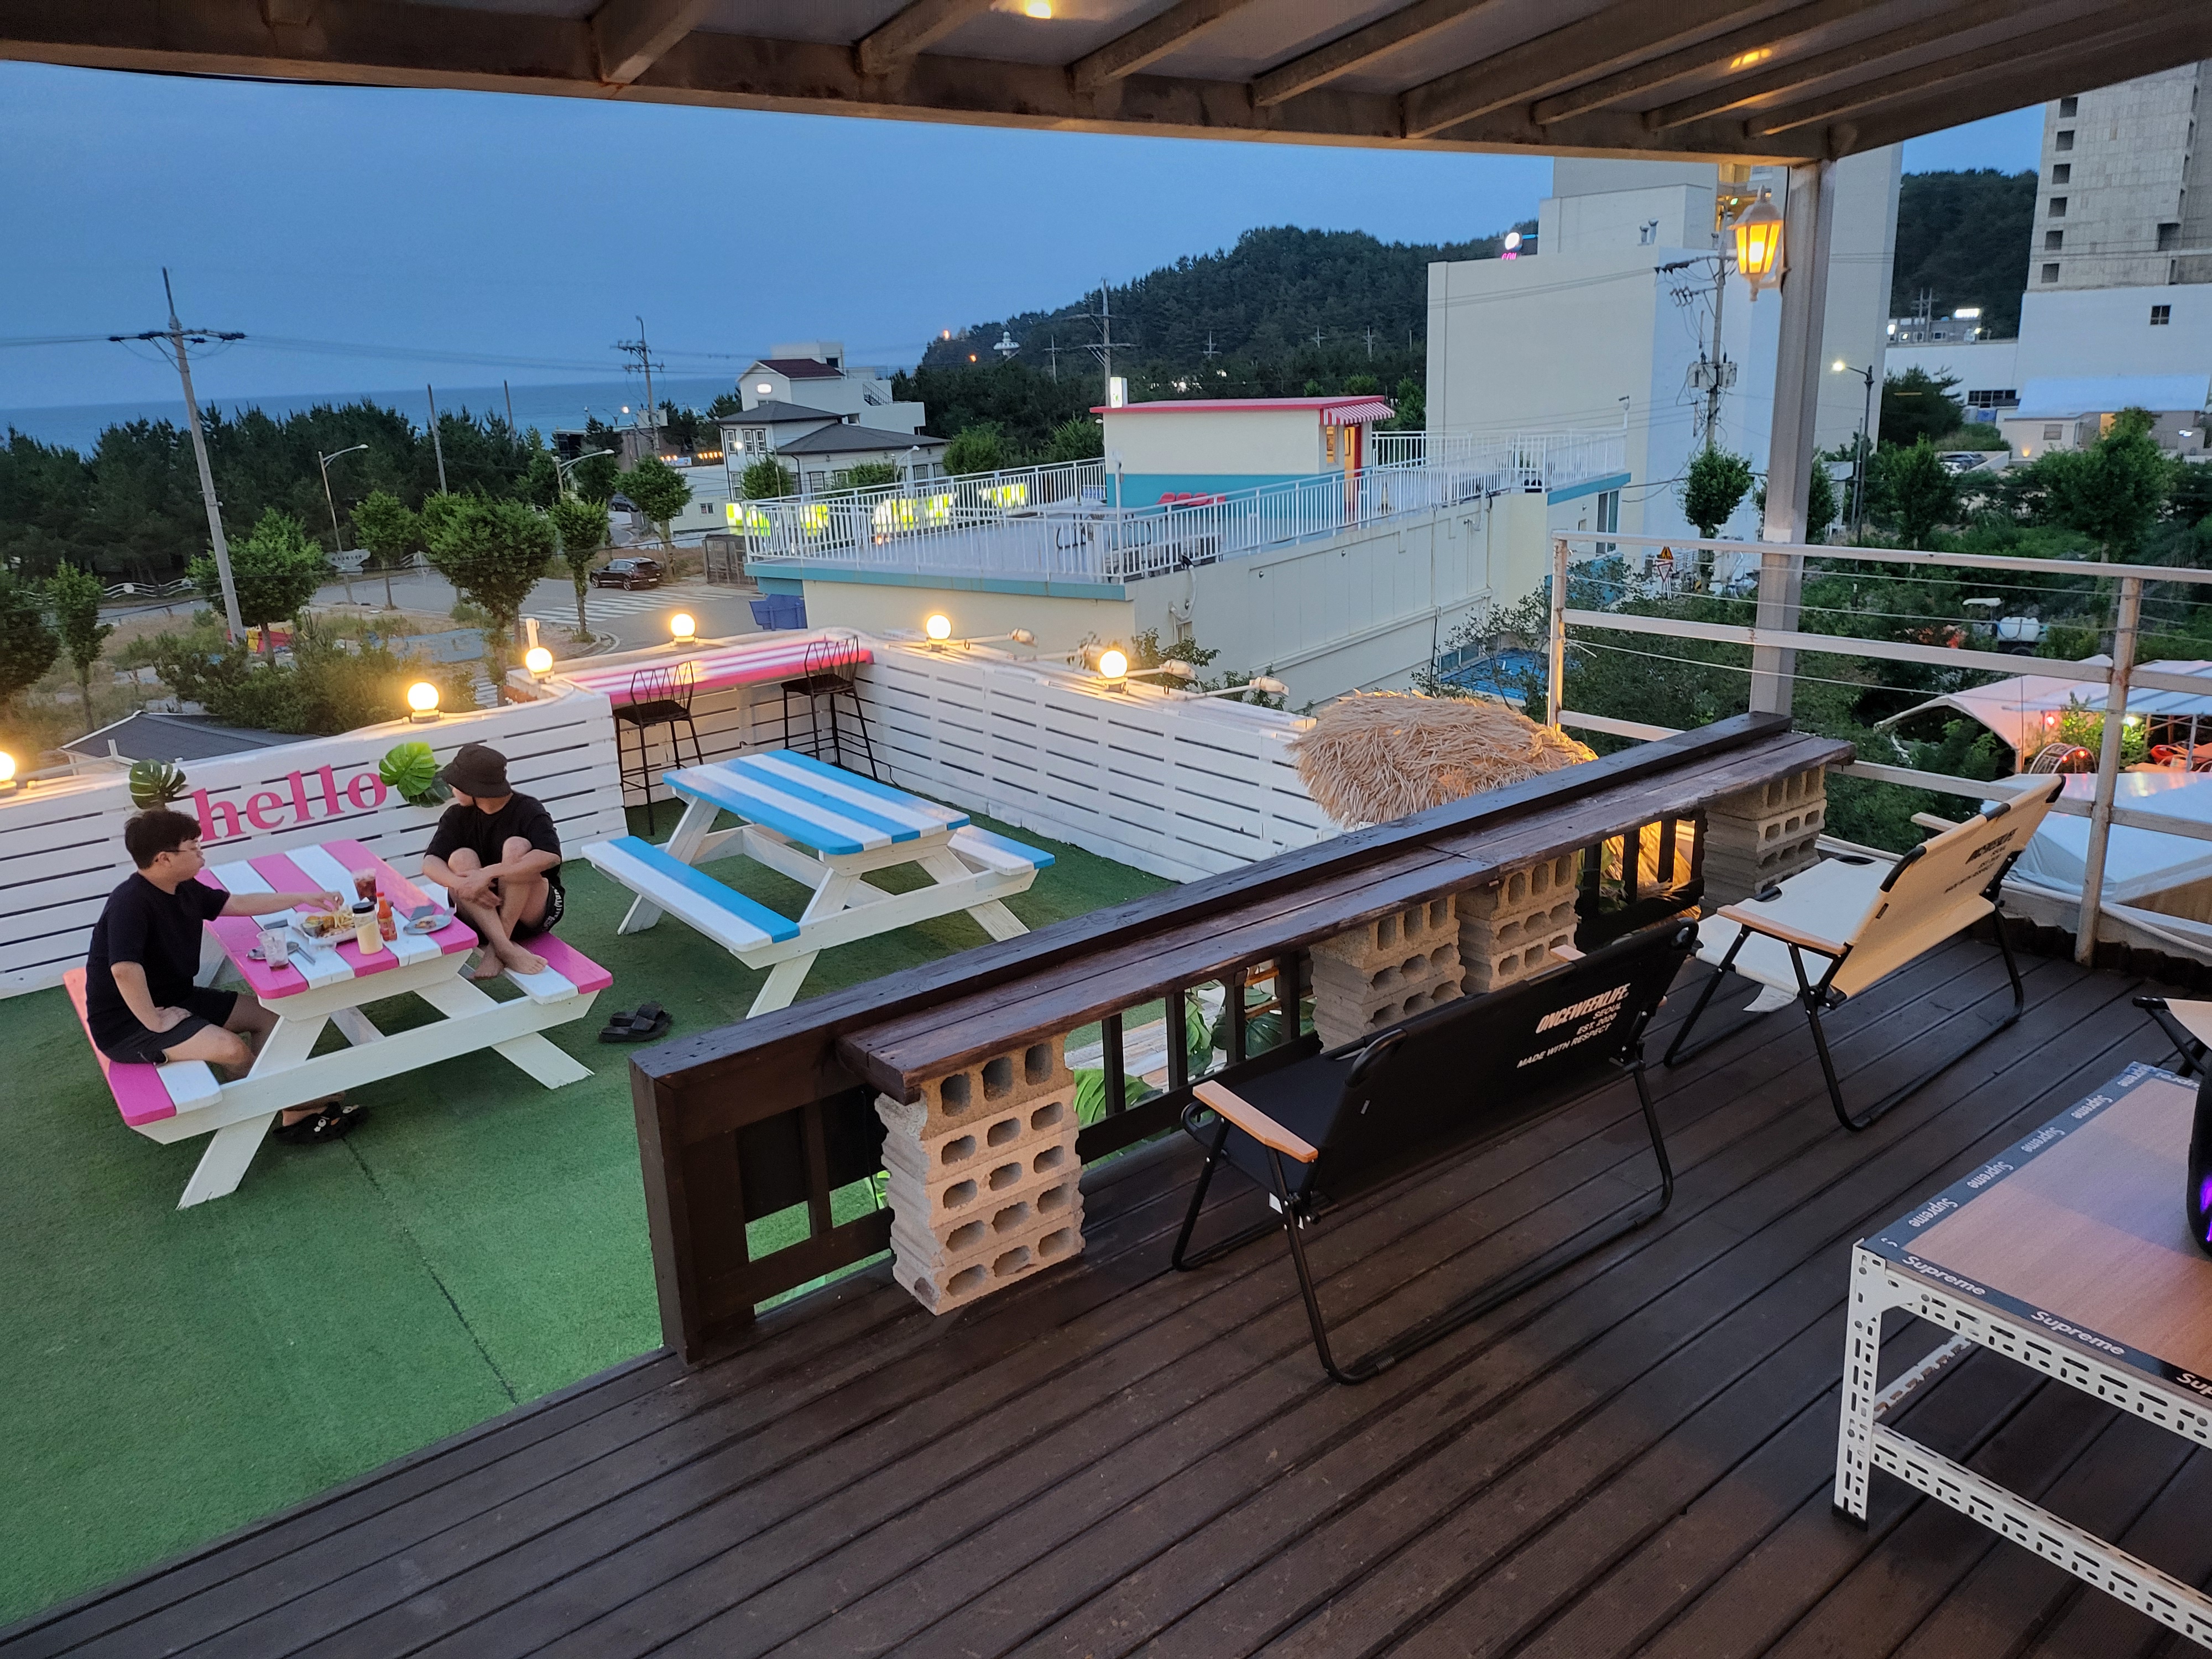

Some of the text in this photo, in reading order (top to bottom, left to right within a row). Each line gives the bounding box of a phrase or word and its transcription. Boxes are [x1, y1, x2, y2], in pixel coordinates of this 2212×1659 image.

[191, 764, 387, 842] hello
[1593, 1001, 1621, 1019] SEOUL
[1516, 1022, 1611, 1068] MADE WITH RESPECT
[2071, 1094, 2113, 1119] Supreme
[2021, 1126, 2065, 1152] Supreme
[1966, 1161, 2014, 1188] Supreme
[1908, 1197, 1959, 1227] Supreme
[1902, 1255, 1986, 1296] Supreme
[2031, 1311, 2125, 1355] Supreme
